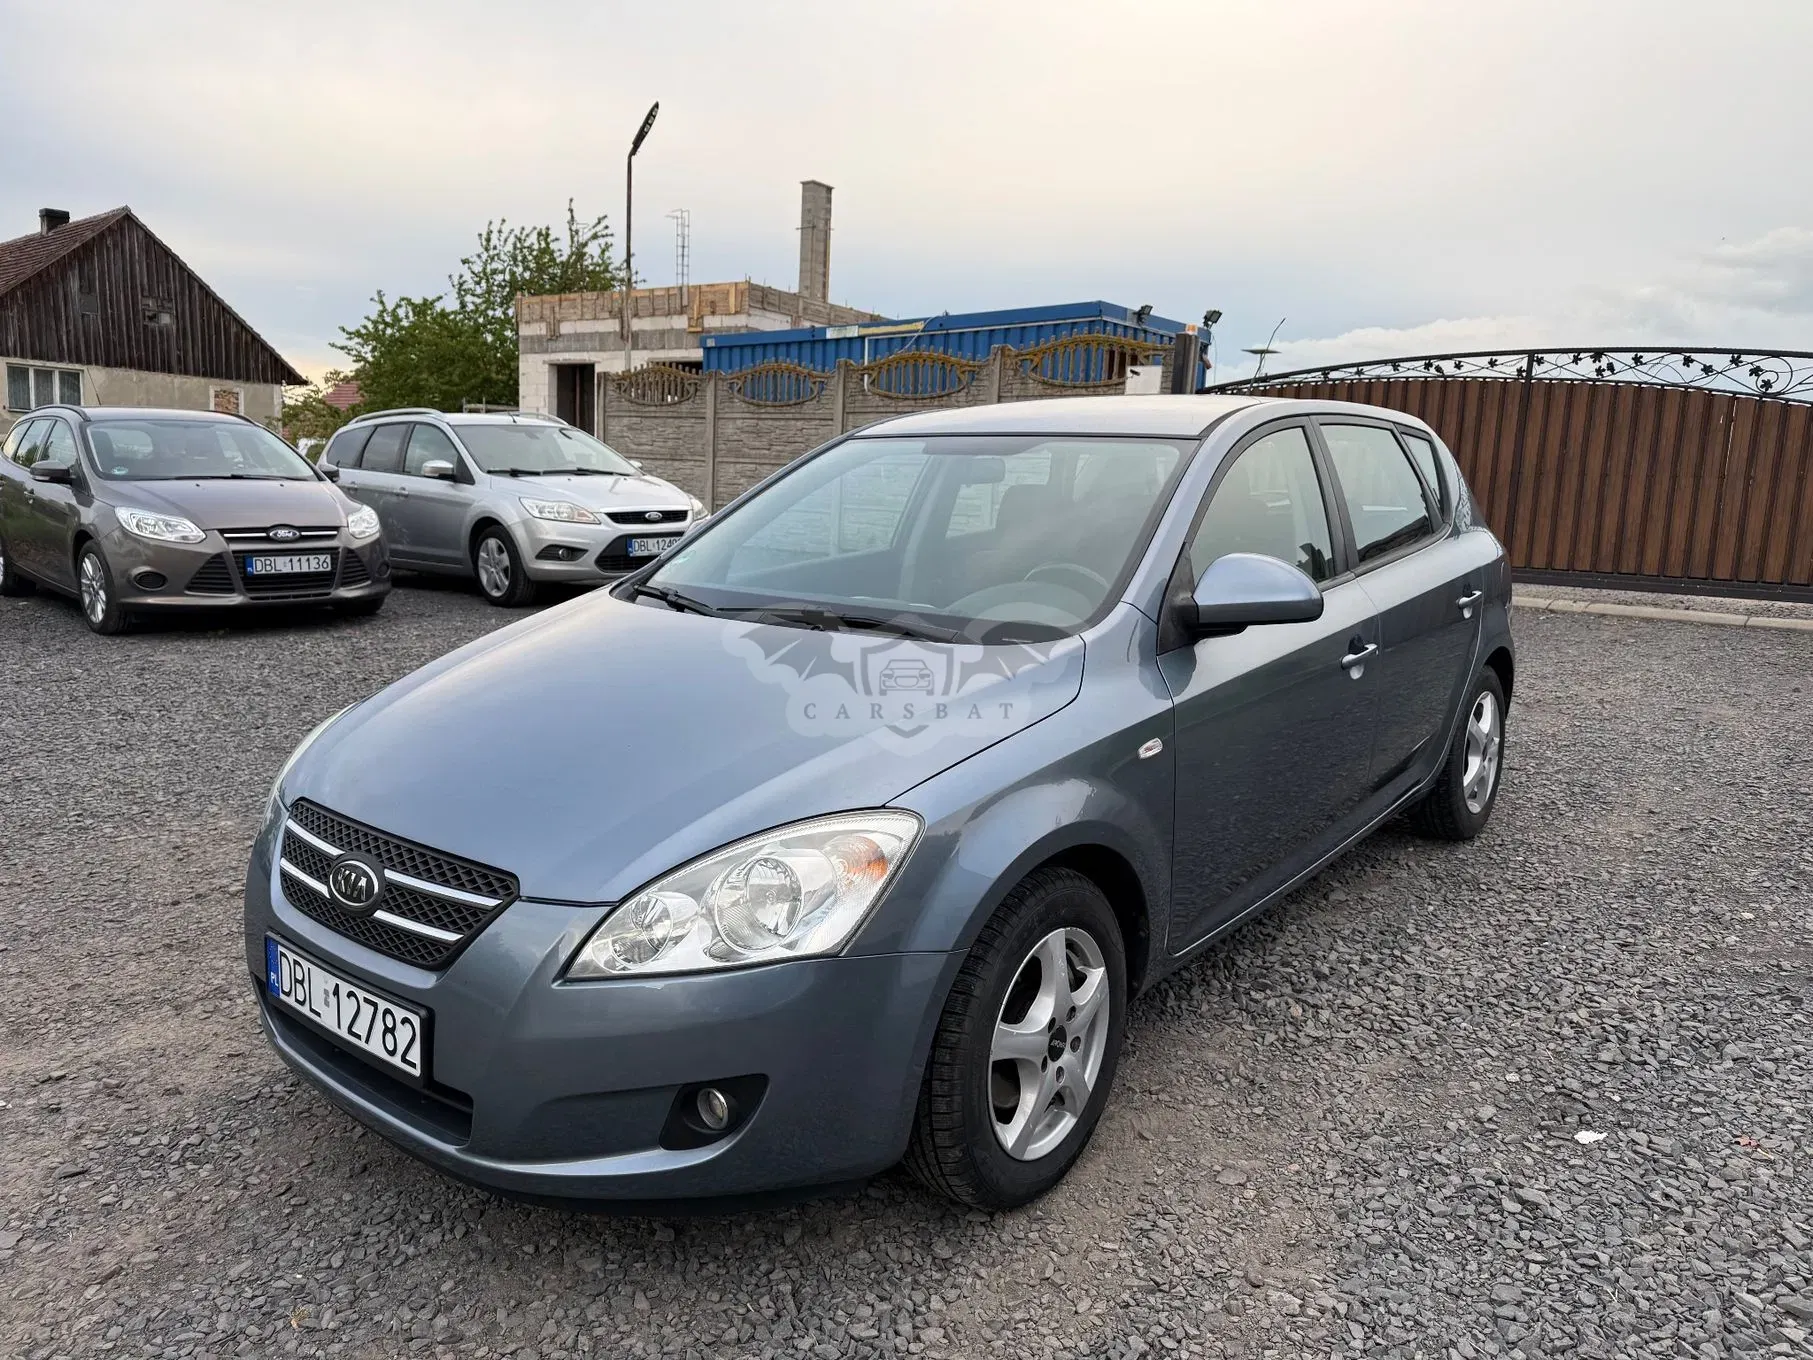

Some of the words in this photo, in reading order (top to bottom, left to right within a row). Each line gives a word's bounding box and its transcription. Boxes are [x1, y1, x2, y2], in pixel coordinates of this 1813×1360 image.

[634, 540, 652, 552] DBL
[254, 558, 282, 573] DBL
[288, 556, 329, 571] 11136
[336, 866, 367, 901] KIA
[270, 971, 279, 988] PL
[280, 950, 321, 1019] DBL
[332, 982, 417, 1070] 12782
